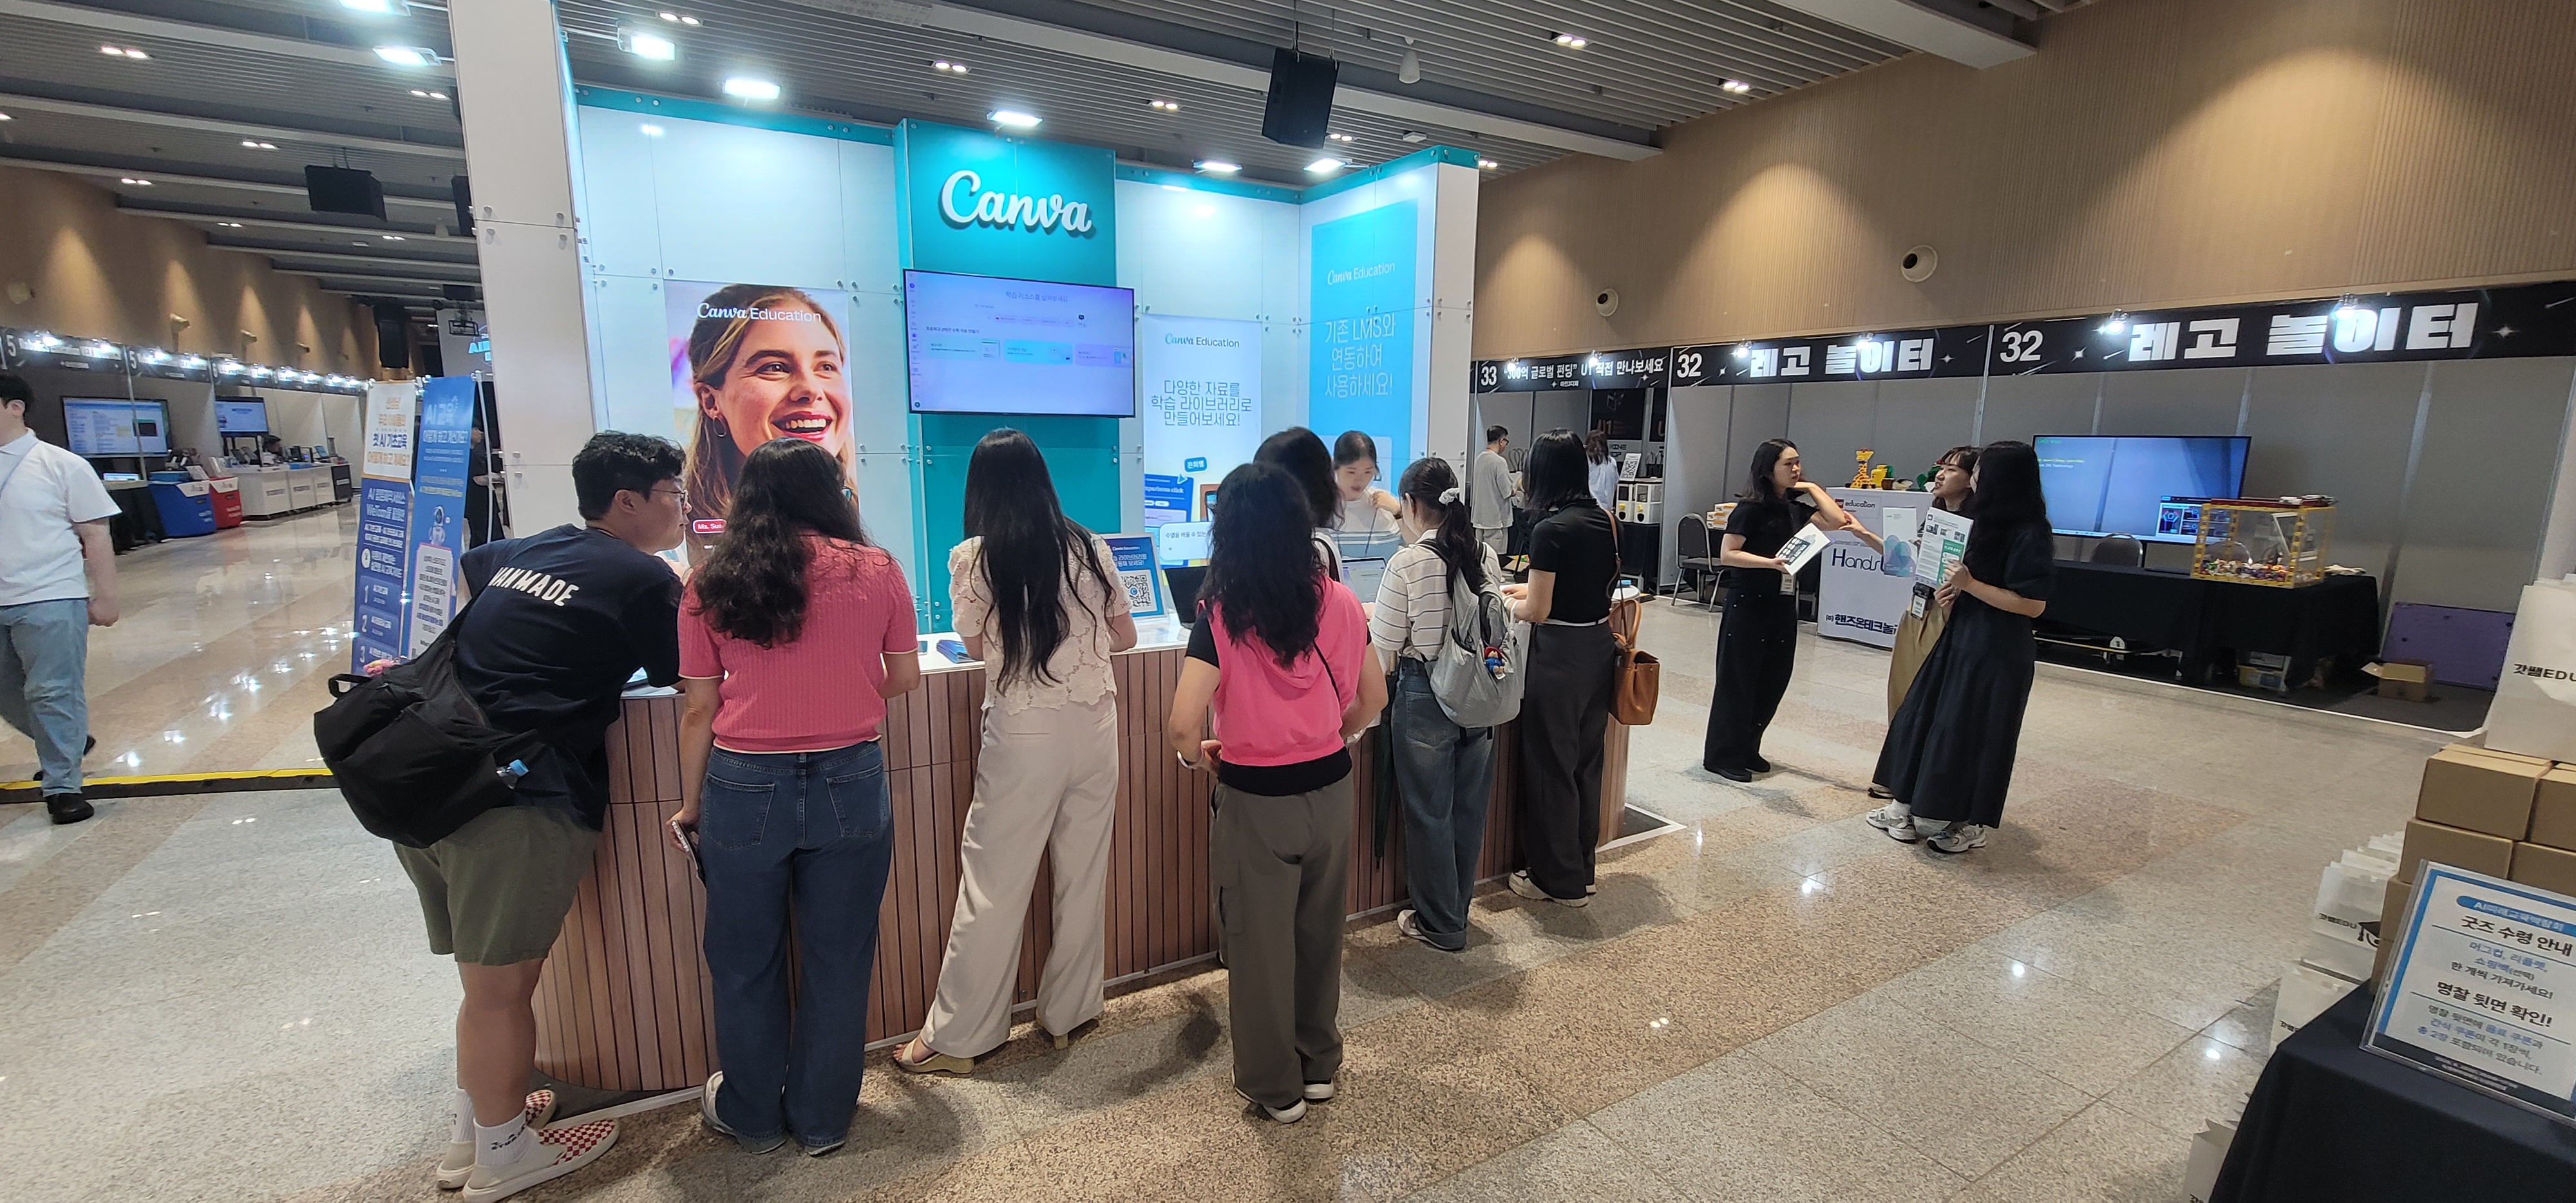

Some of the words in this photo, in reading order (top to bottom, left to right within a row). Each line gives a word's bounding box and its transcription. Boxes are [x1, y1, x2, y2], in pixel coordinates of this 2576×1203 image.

[941, 169, 1093, 233] Canva
[1327, 270, 1352, 285] Canva
[1354, 263, 1395, 279] Education
[696, 302, 747, 319] Canva
[750, 308, 821, 322] Education
[1325, 319, 1349, 345] 기존
[1353, 312, 1396, 340] LMS와
[2128, 319, 2240, 362] 레고
[2266, 303, 2478, 357] 놀이터
[1164, 333, 1194, 345] Canva
[1196, 337, 1240, 348] Education
[2000, 332, 2041, 363] 32
[1331, 343, 1382, 371] 연동하여
[1676, 353, 1702, 378] 32
[1750, 346, 1811, 378] 레고
[1824, 338, 1935, 374] 놀이터
[1481, 366, 1497, 386] 33
[1531, 365, 1554, 380] 글로벌
[1595, 361, 1613, 377] 직접
[1616, 358, 1663, 375] 만나보세요
[1164, 380, 1201, 395] 다양한
[1205, 381, 1240, 397] 자료를
[1325, 372, 1393, 398] 사용하세요!
[424, 404, 436, 425] AI
[1151, 395, 1176, 410] 학습
[1180, 396, 1252, 412] 라이브러리로
[1164, 411, 1240, 426] 만들어보세요!
[1845, 500, 1875, 509] education
[2461, 915, 2496, 934] 굿즈
[2498, 927, 2533, 945] 수령
[2537, 936, 2573, 956] 안내
[2451, 961, 2462, 972] 한
[2465, 966, 2488, 980] 개씩
[2437, 981, 2470, 1001] 명찰
[2473, 993, 2507, 1014] 뒷면
[2510, 1005, 2553, 1027] 확인!
